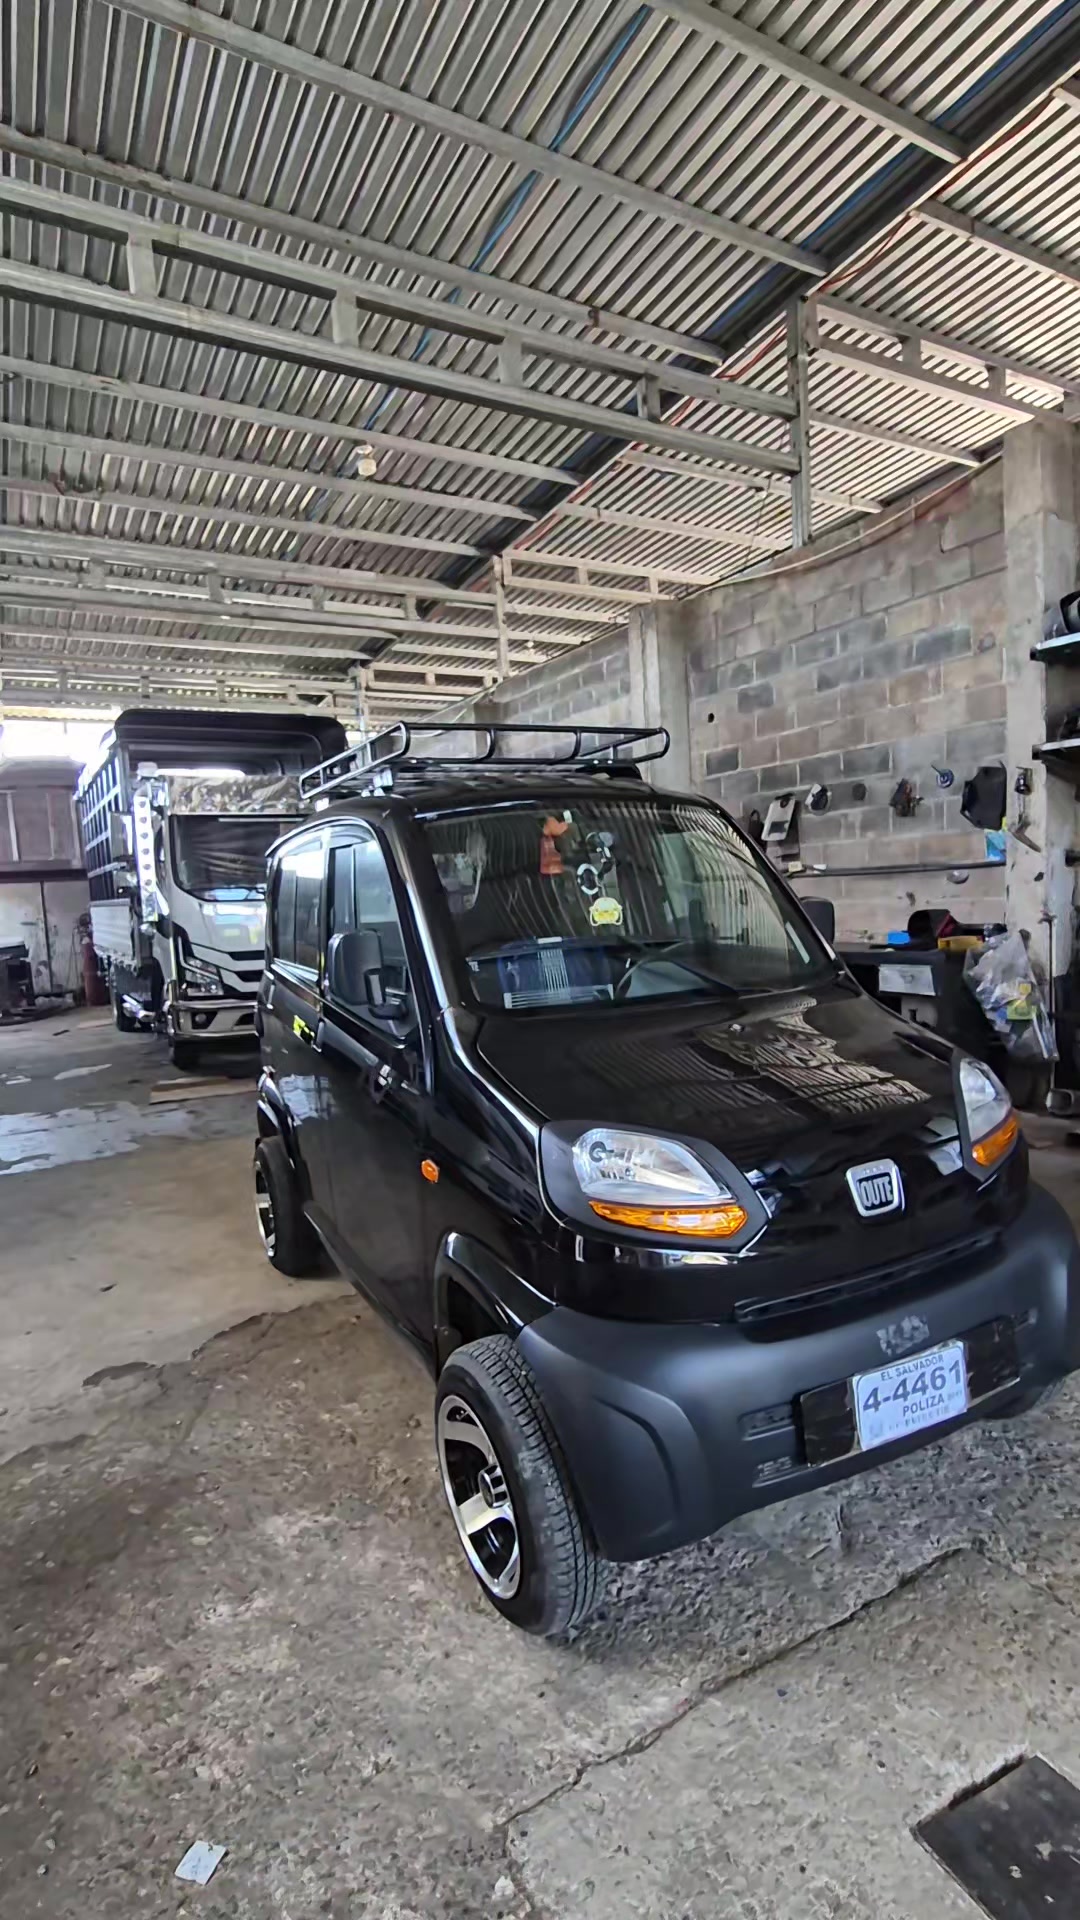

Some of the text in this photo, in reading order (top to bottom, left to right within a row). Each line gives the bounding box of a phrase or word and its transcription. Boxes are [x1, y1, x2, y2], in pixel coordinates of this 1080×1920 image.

[880, 1354, 944, 1381] EL SALVADOR
[863, 1360, 961, 1413] 4-4461
[903, 1393, 945, 1417] POLIZA
